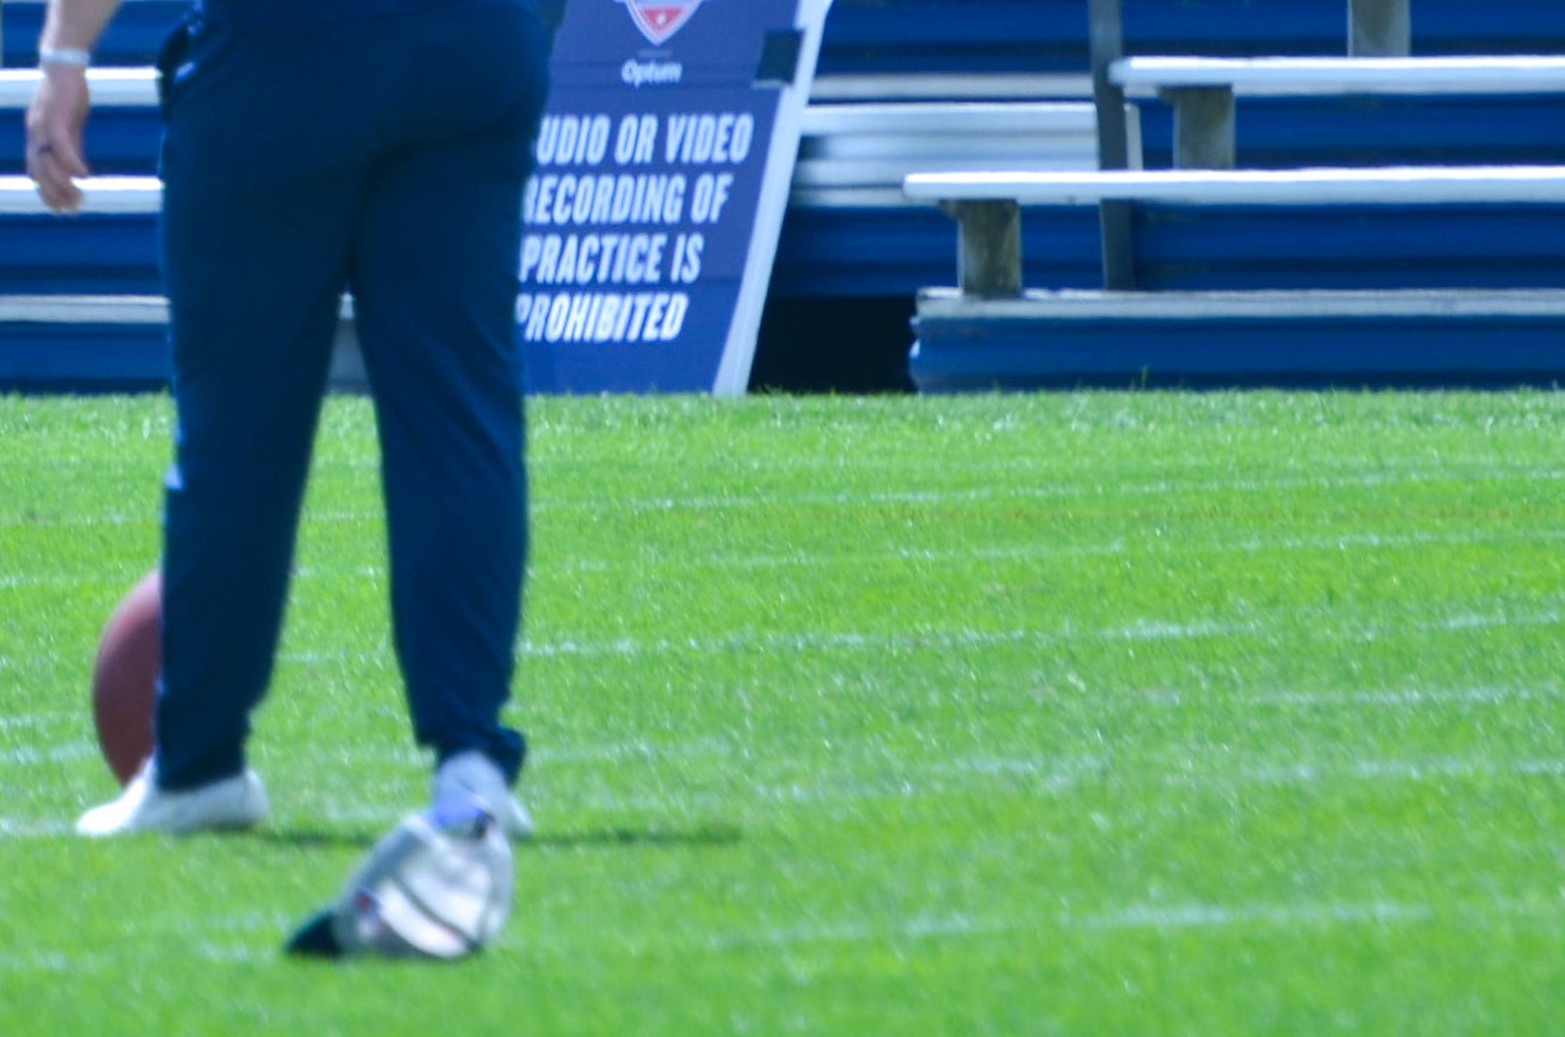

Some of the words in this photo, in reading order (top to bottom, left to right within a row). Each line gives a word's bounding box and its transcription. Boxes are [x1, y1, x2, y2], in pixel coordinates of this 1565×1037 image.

[532, 114, 612, 165] UDIO
[614, 114, 659, 165] OR
[665, 113, 755, 164] VIDEO
[690, 171, 734, 225] OF
[518, 233, 668, 284] PRACTICE
[670, 232, 705, 284] IS
